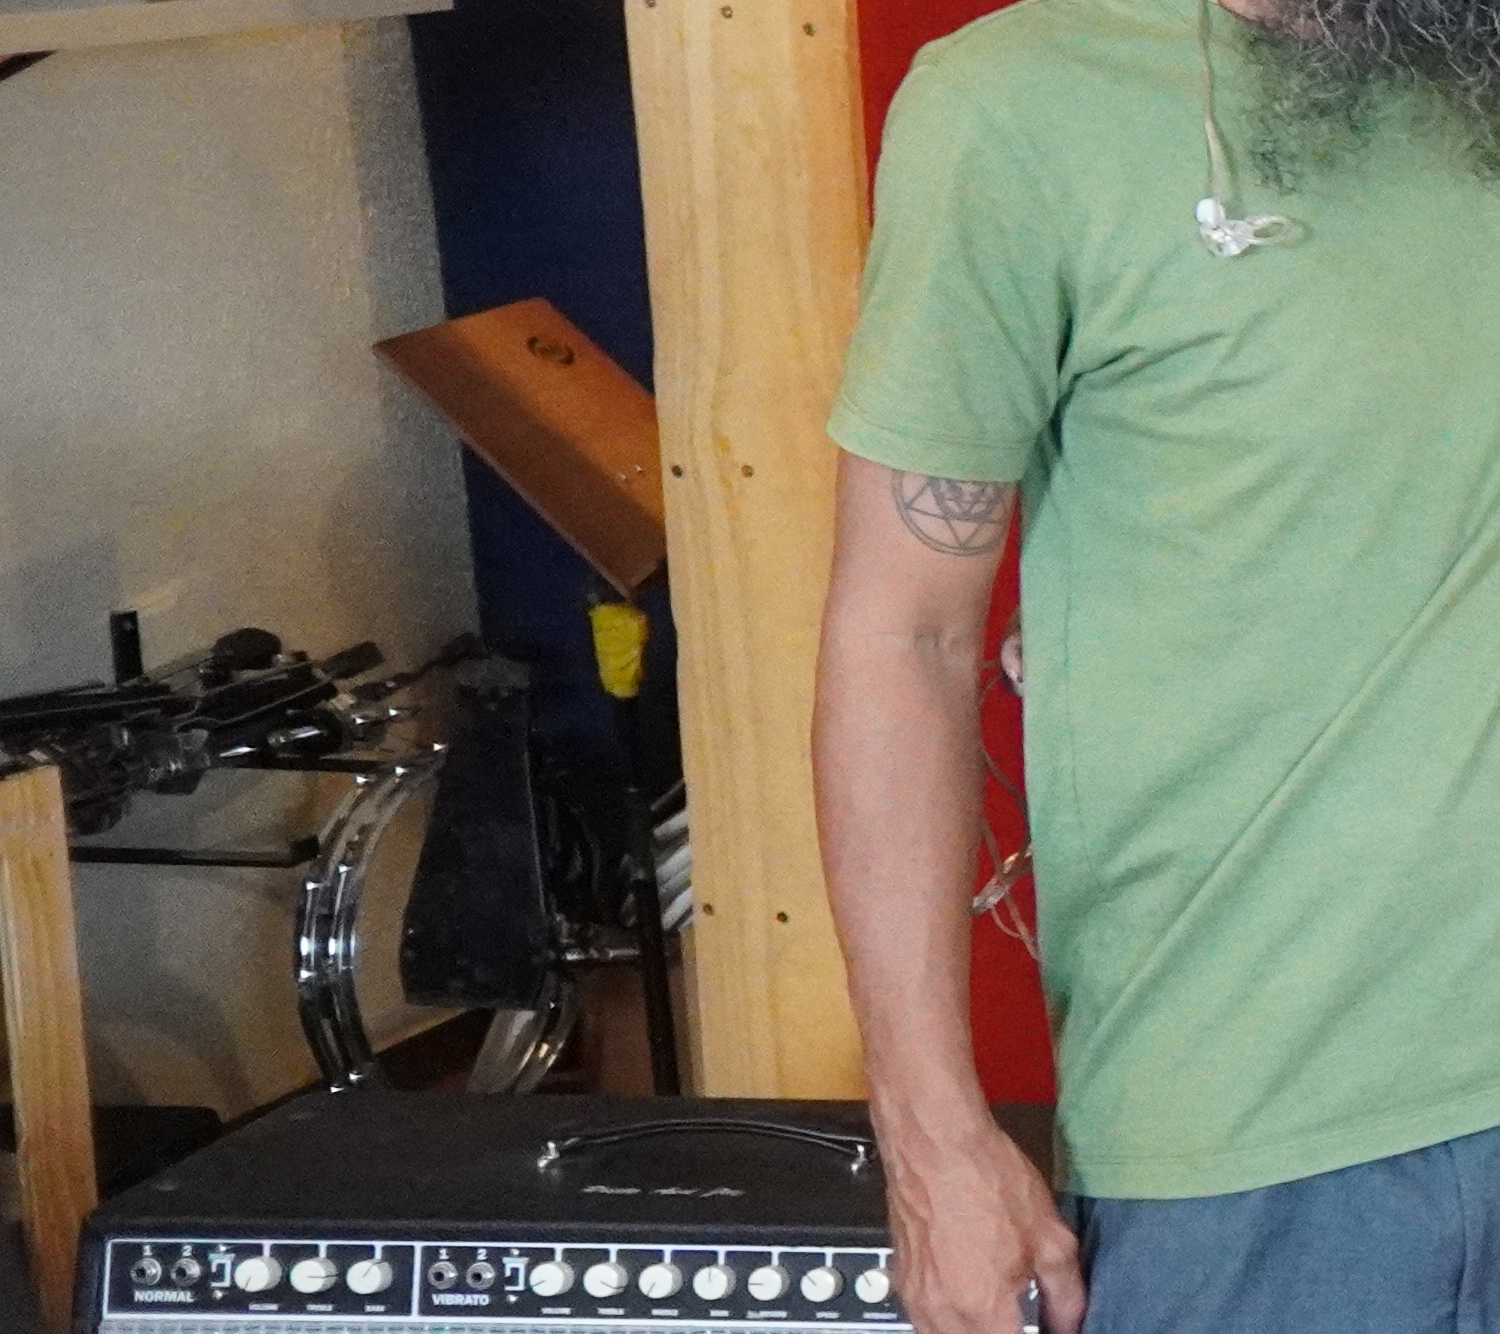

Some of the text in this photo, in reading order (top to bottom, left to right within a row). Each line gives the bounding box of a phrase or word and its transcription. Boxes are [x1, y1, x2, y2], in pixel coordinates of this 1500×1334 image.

[141, 1244, 194, 1256] 1 2
[438, 1247, 488, 1260] 1 2
[133, 1289, 196, 1304] NORMAL
[431, 1292, 491, 1307] VIBRATO
